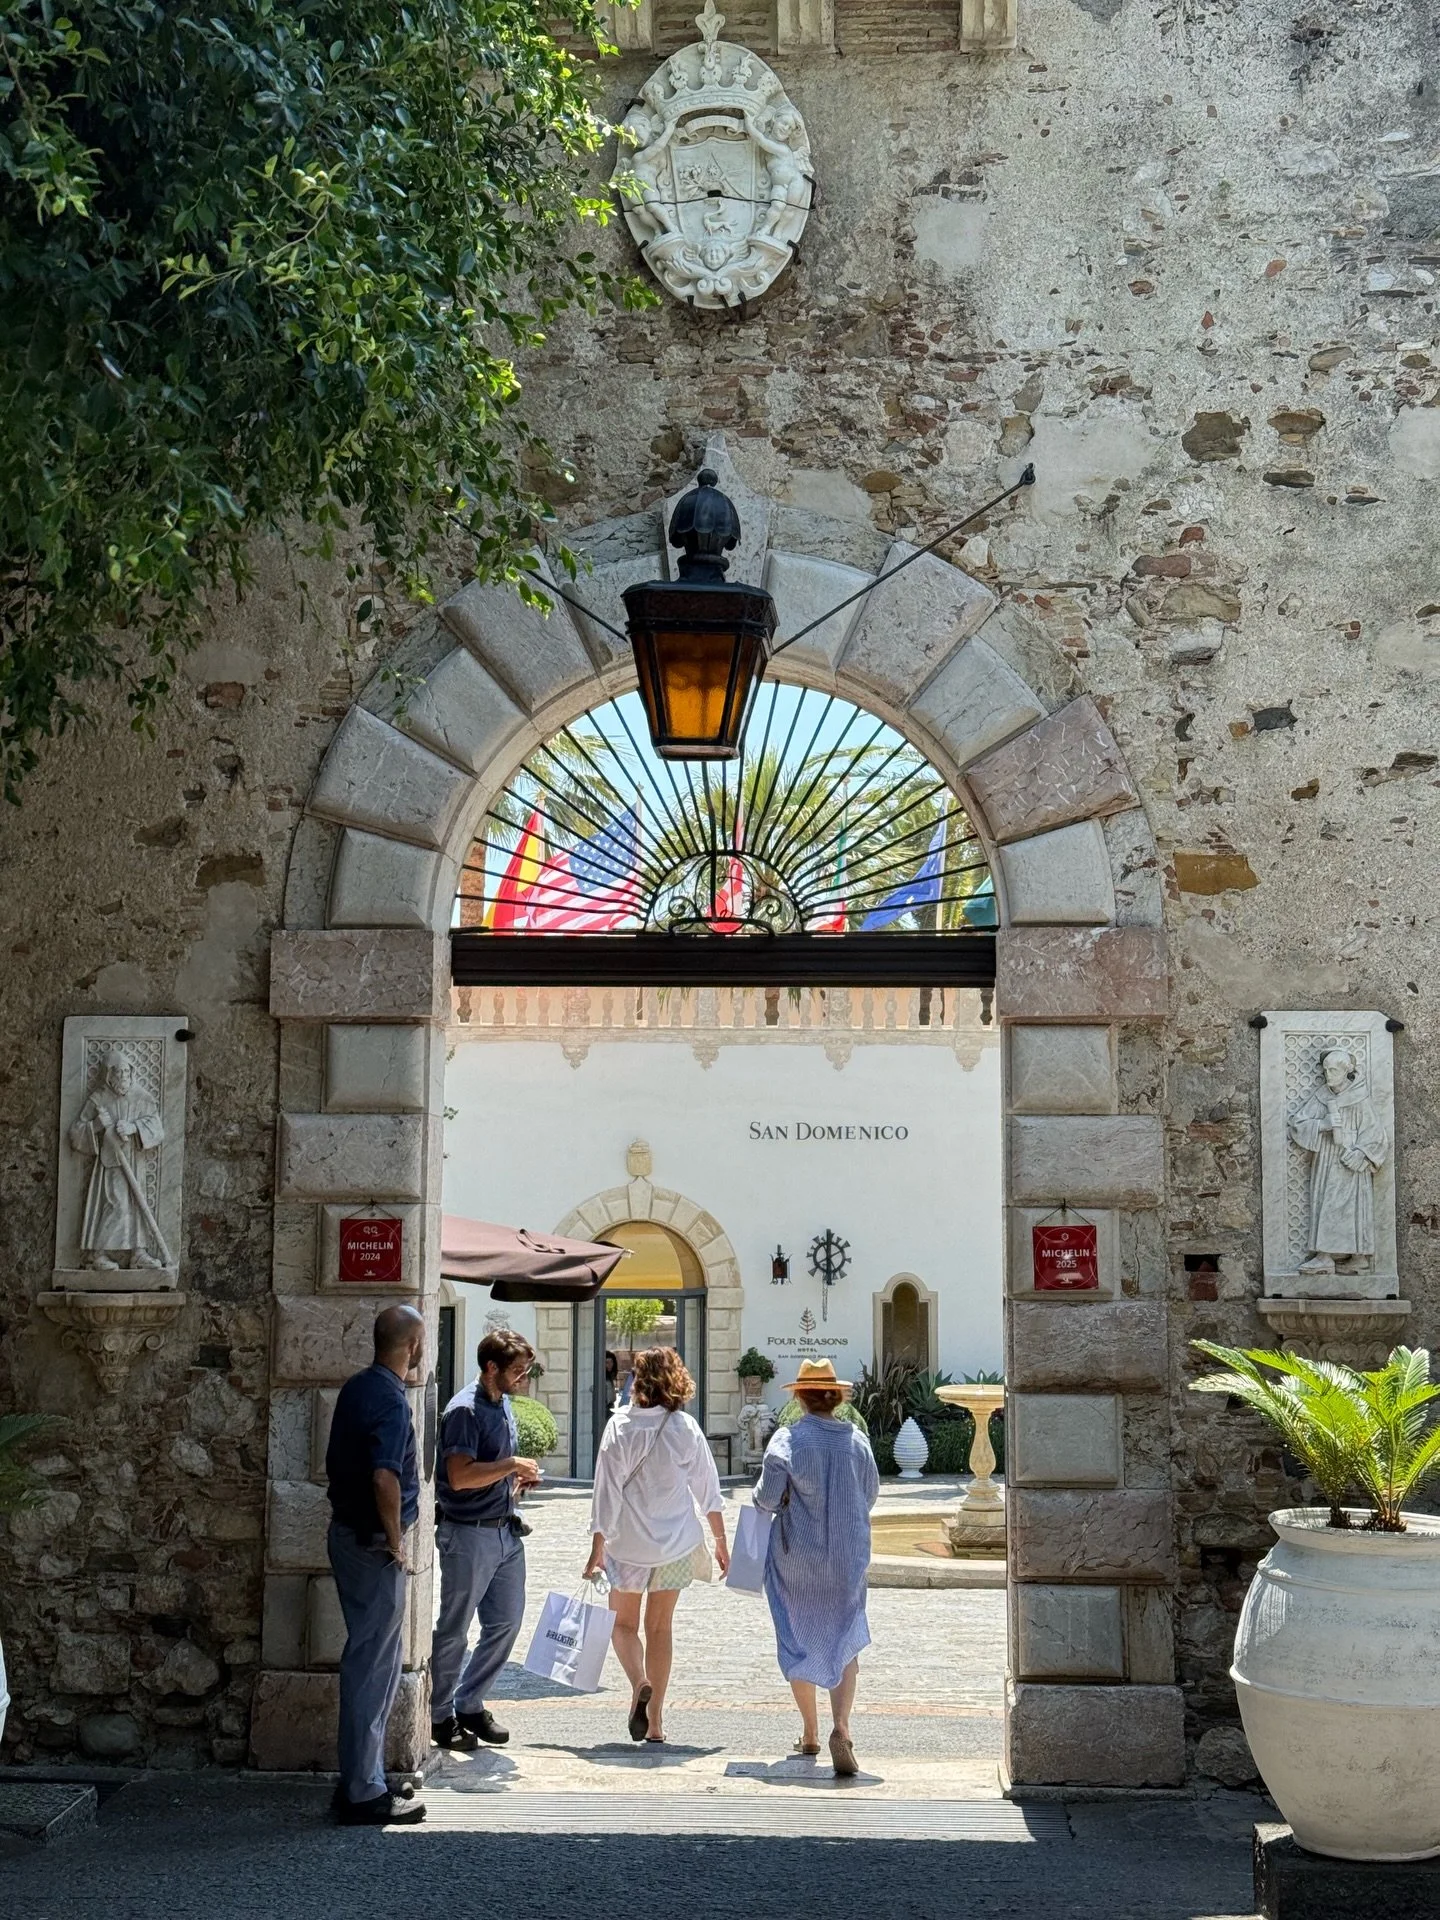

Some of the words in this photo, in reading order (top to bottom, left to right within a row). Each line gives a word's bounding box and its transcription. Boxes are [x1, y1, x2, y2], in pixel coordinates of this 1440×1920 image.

[795, 1122, 909, 1141] DOMENICO
[347, 1241, 394, 1250] MICHELIN
[359, 1252, 381, 1261] 2024
[1041, 1248, 1090, 1258] MICHELIN
[1055, 1259, 1077, 1269] 2025
[767, 1336, 797, 1346] FOUR
[798, 1336, 849, 1346] SEASONS
